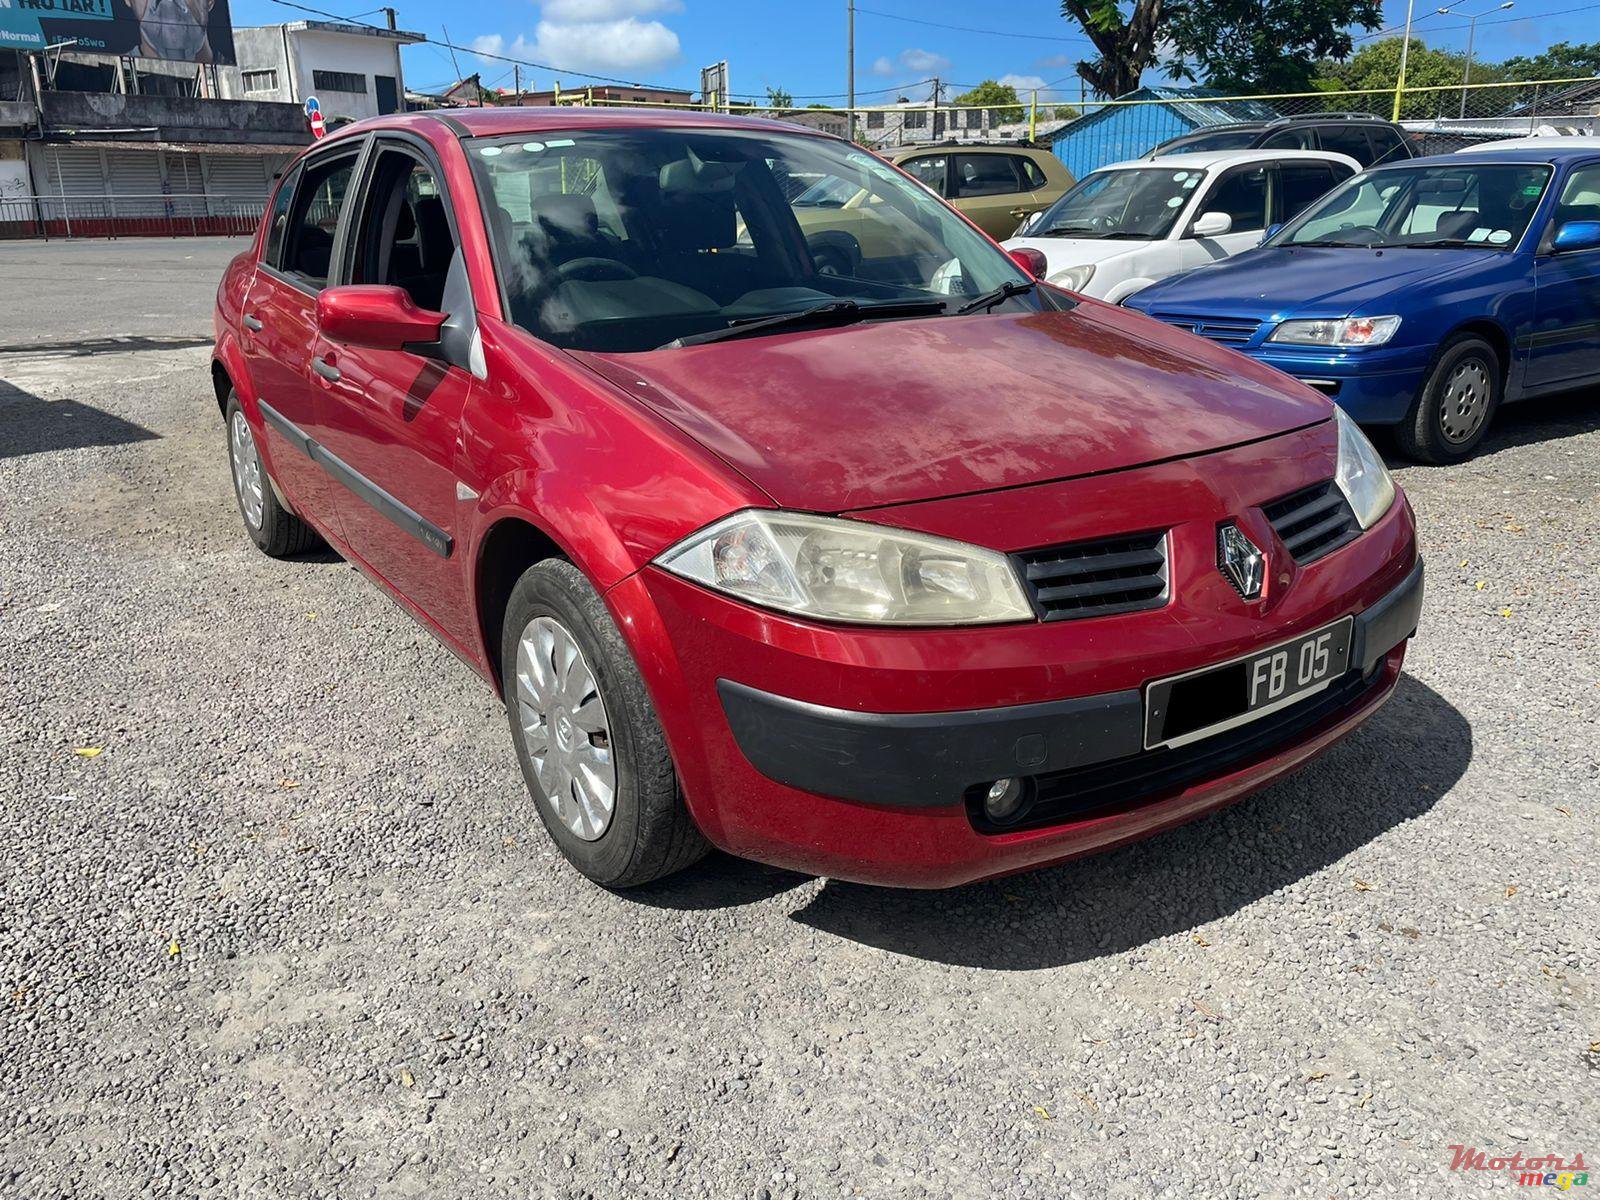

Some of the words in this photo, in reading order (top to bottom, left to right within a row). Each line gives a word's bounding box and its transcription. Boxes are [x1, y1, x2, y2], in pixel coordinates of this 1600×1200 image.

[0, 30, 40, 43] Normal
[1250, 651, 1288, 706] FB
[1297, 632, 1332, 686] 05
